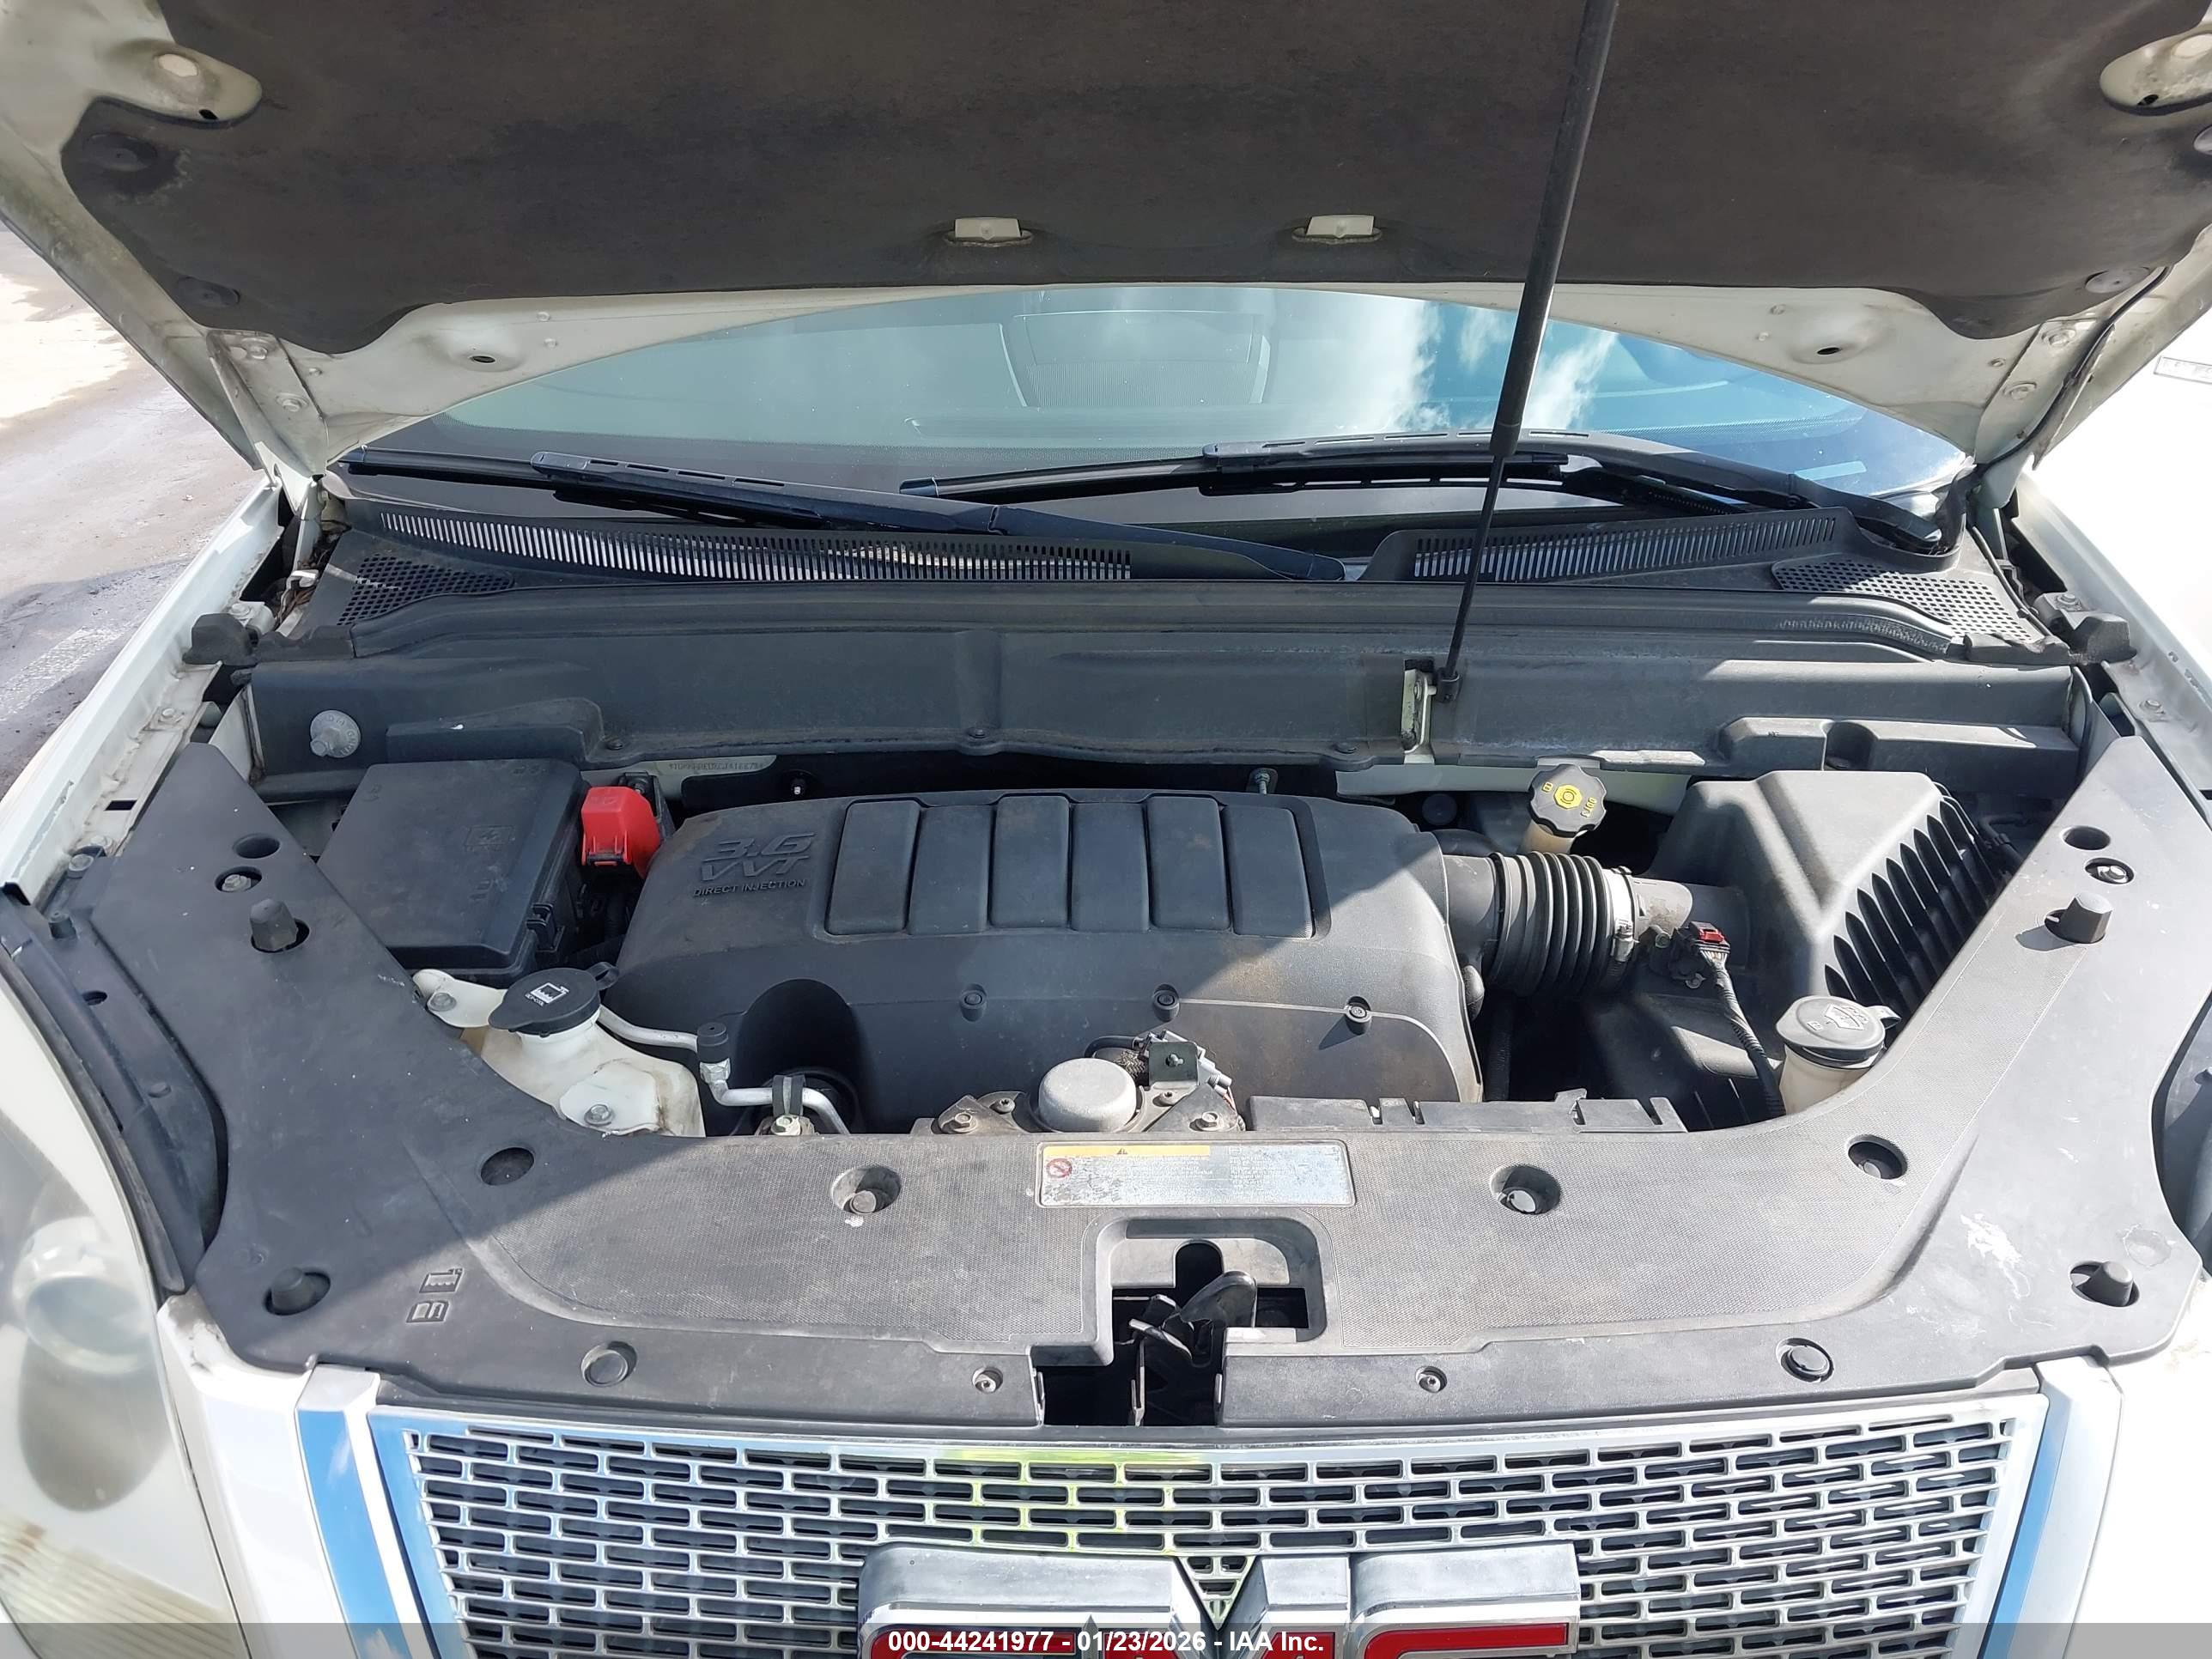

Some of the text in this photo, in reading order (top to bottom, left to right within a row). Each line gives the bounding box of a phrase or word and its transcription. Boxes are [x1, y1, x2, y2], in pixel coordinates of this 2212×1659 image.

[717, 831, 816, 857] 3.6
[701, 855, 811, 882] VVT
[692, 878, 806, 897] DIRECT INJECTION
